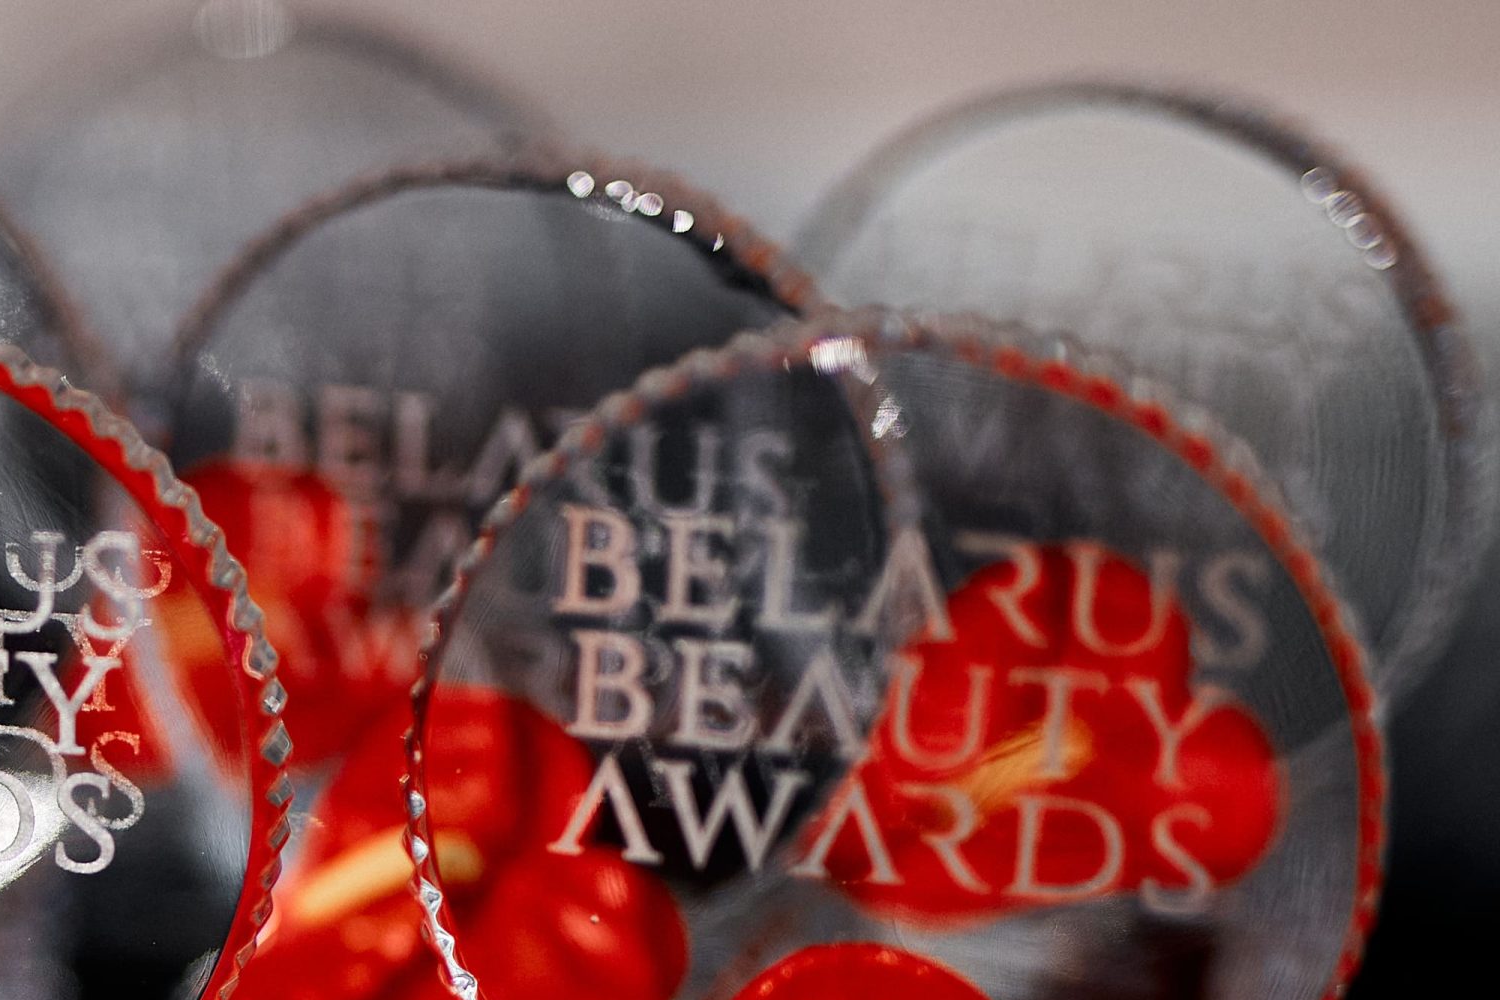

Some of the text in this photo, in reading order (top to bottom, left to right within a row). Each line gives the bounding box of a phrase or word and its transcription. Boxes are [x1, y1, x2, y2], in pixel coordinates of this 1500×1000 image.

[553, 503, 1270, 669] BELARUS
[566, 629, 1238, 790] BEAUTY
[548, 752, 1218, 918] AWARDS
